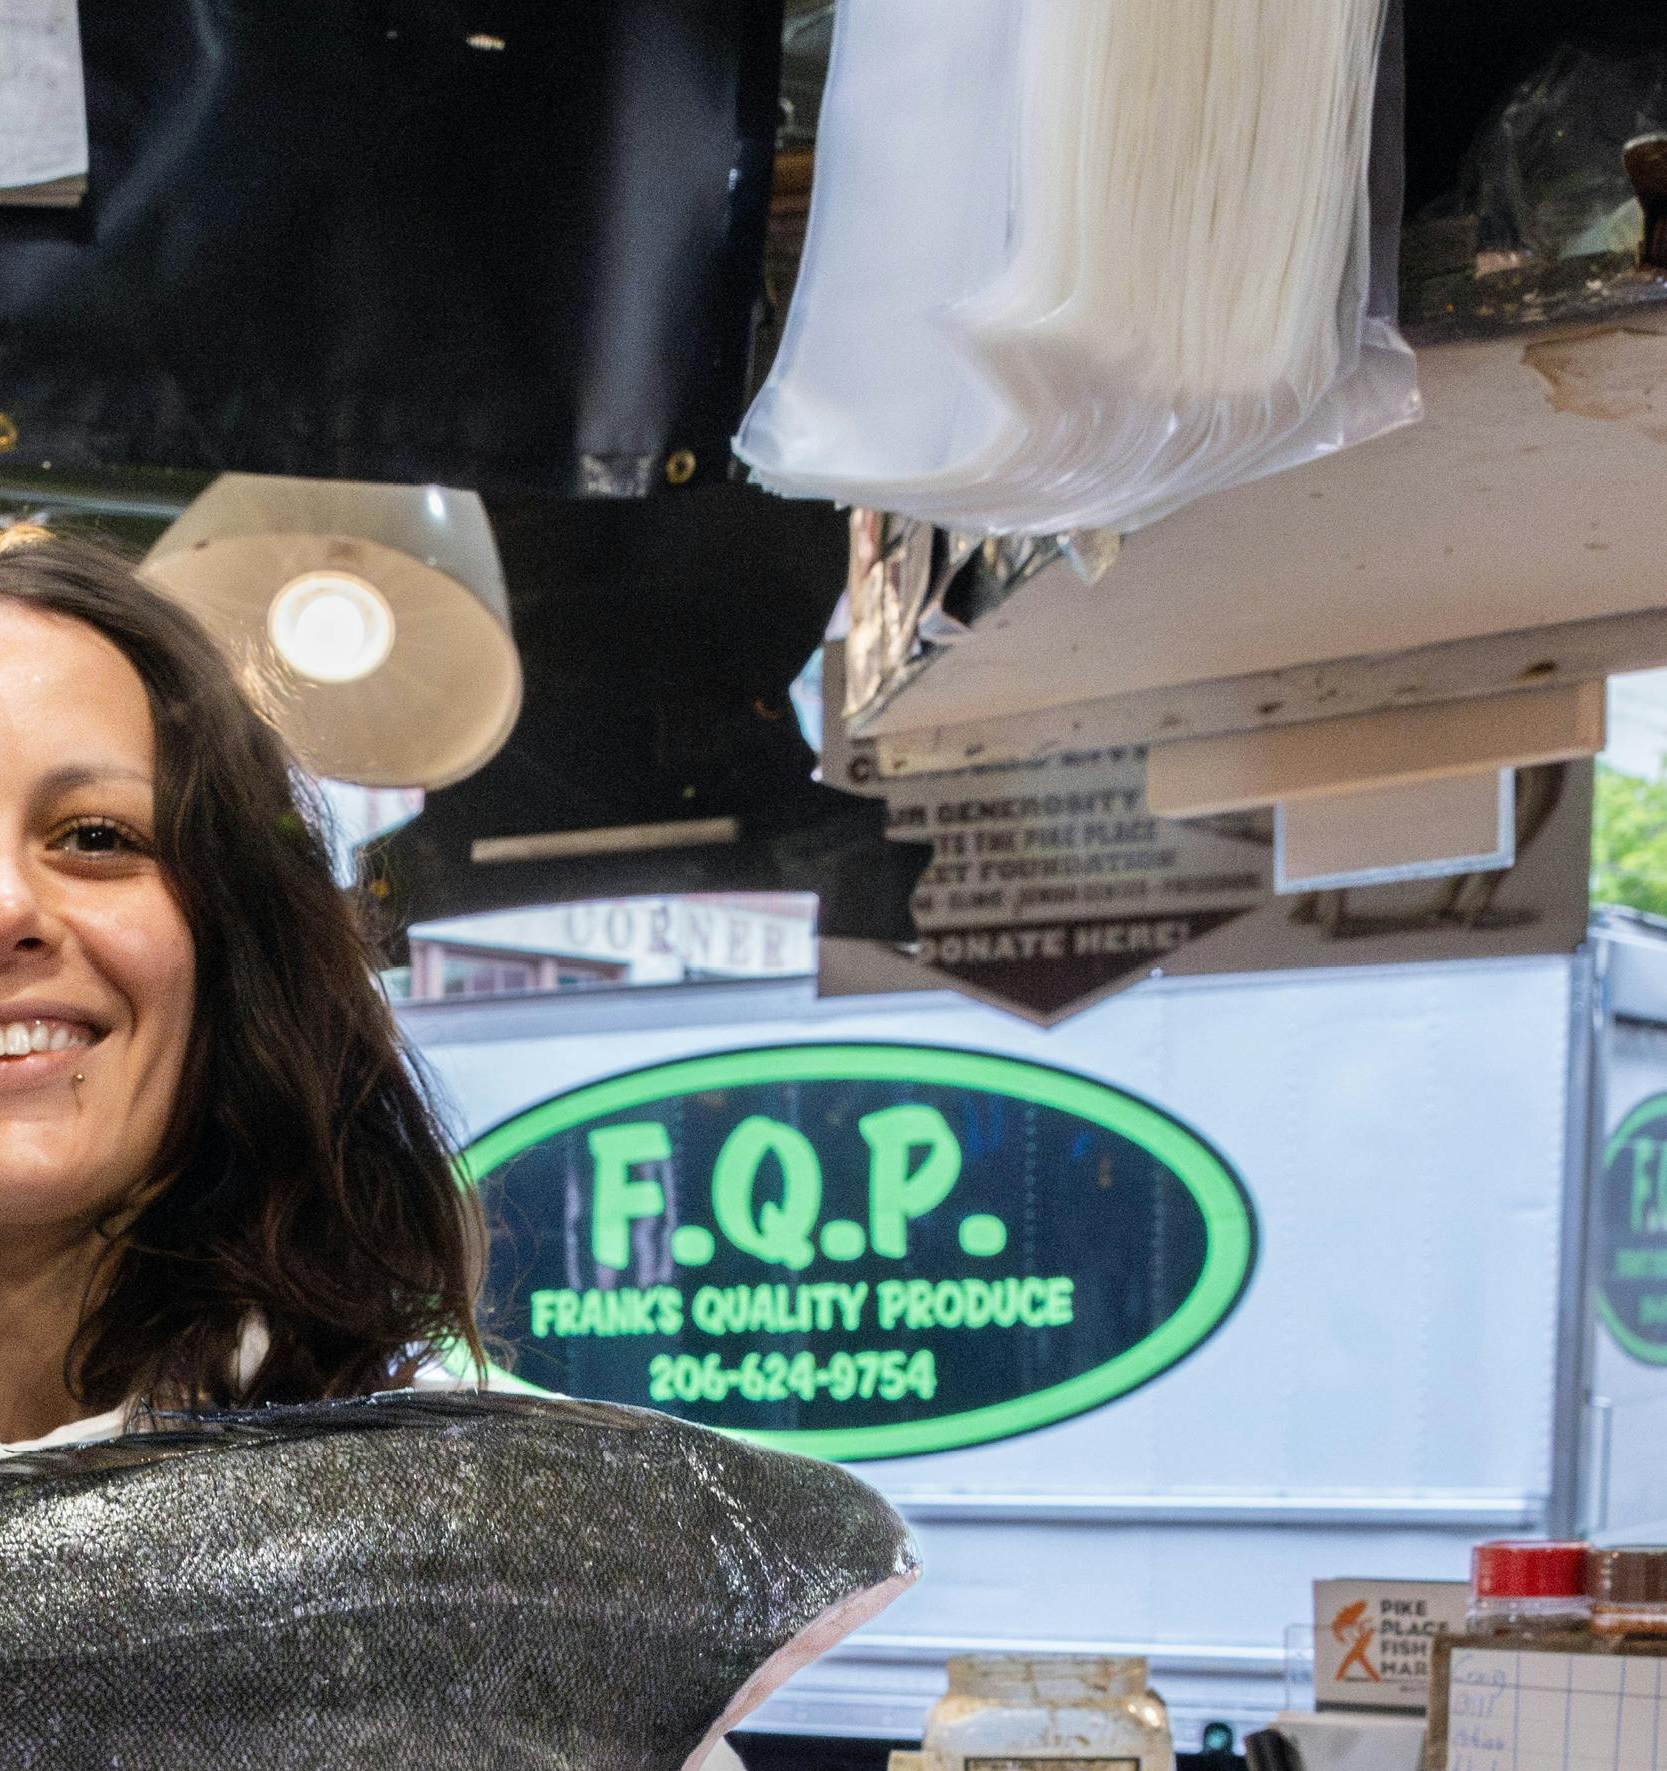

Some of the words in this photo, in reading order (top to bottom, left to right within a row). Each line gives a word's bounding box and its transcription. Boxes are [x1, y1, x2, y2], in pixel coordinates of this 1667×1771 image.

[937, 788, 1142, 825] GENEROSITY
[587, 1103, 1007, 1271] F.Q.P.
[691, 1281, 869, 1335] QUALITY
[876, 1276, 1075, 1330] PRODUCE
[649, 1349, 937, 1402] 206-624-9754
[1380, 1599, 1427, 1616] PIKE
[1380, 1618, 1449, 1636] PLACE
[1380, 1638, 1427, 1655] FISH
[1380, 1660, 1428, 1676] MAR
